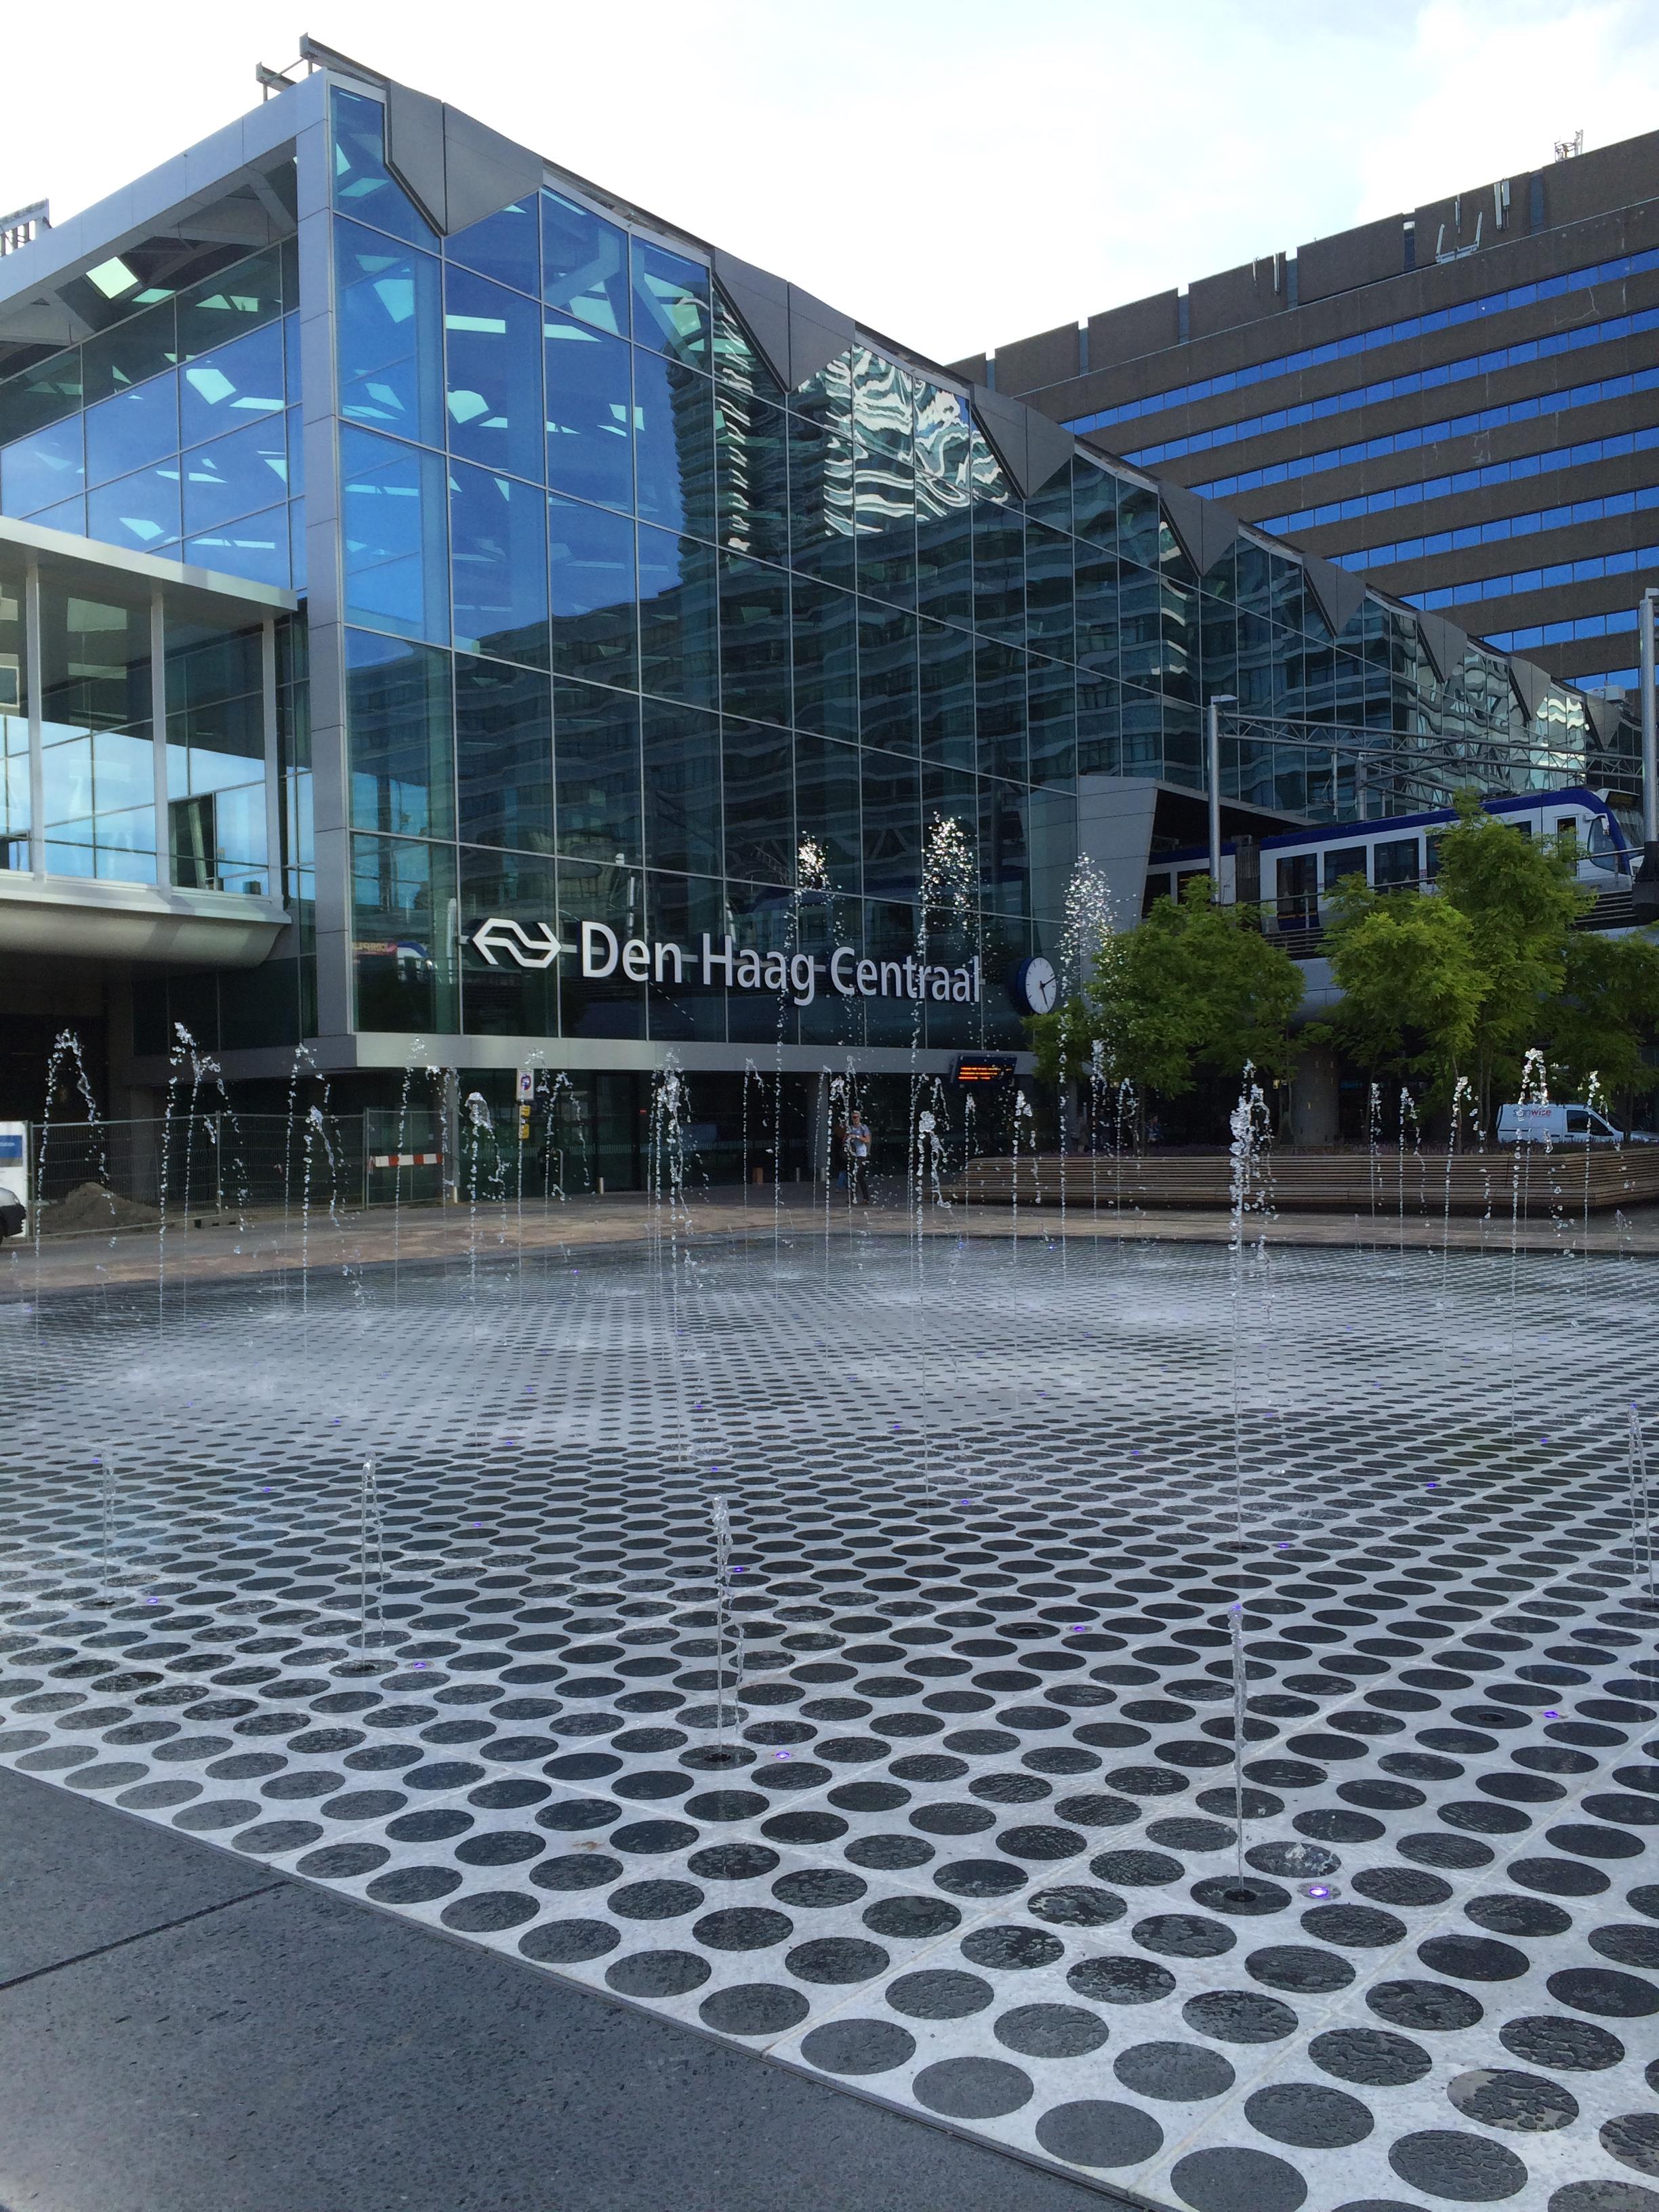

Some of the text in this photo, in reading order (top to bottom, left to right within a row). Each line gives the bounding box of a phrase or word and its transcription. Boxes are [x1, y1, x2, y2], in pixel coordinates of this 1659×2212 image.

[582, 921, 979, 1006] Den Haag Centraal
